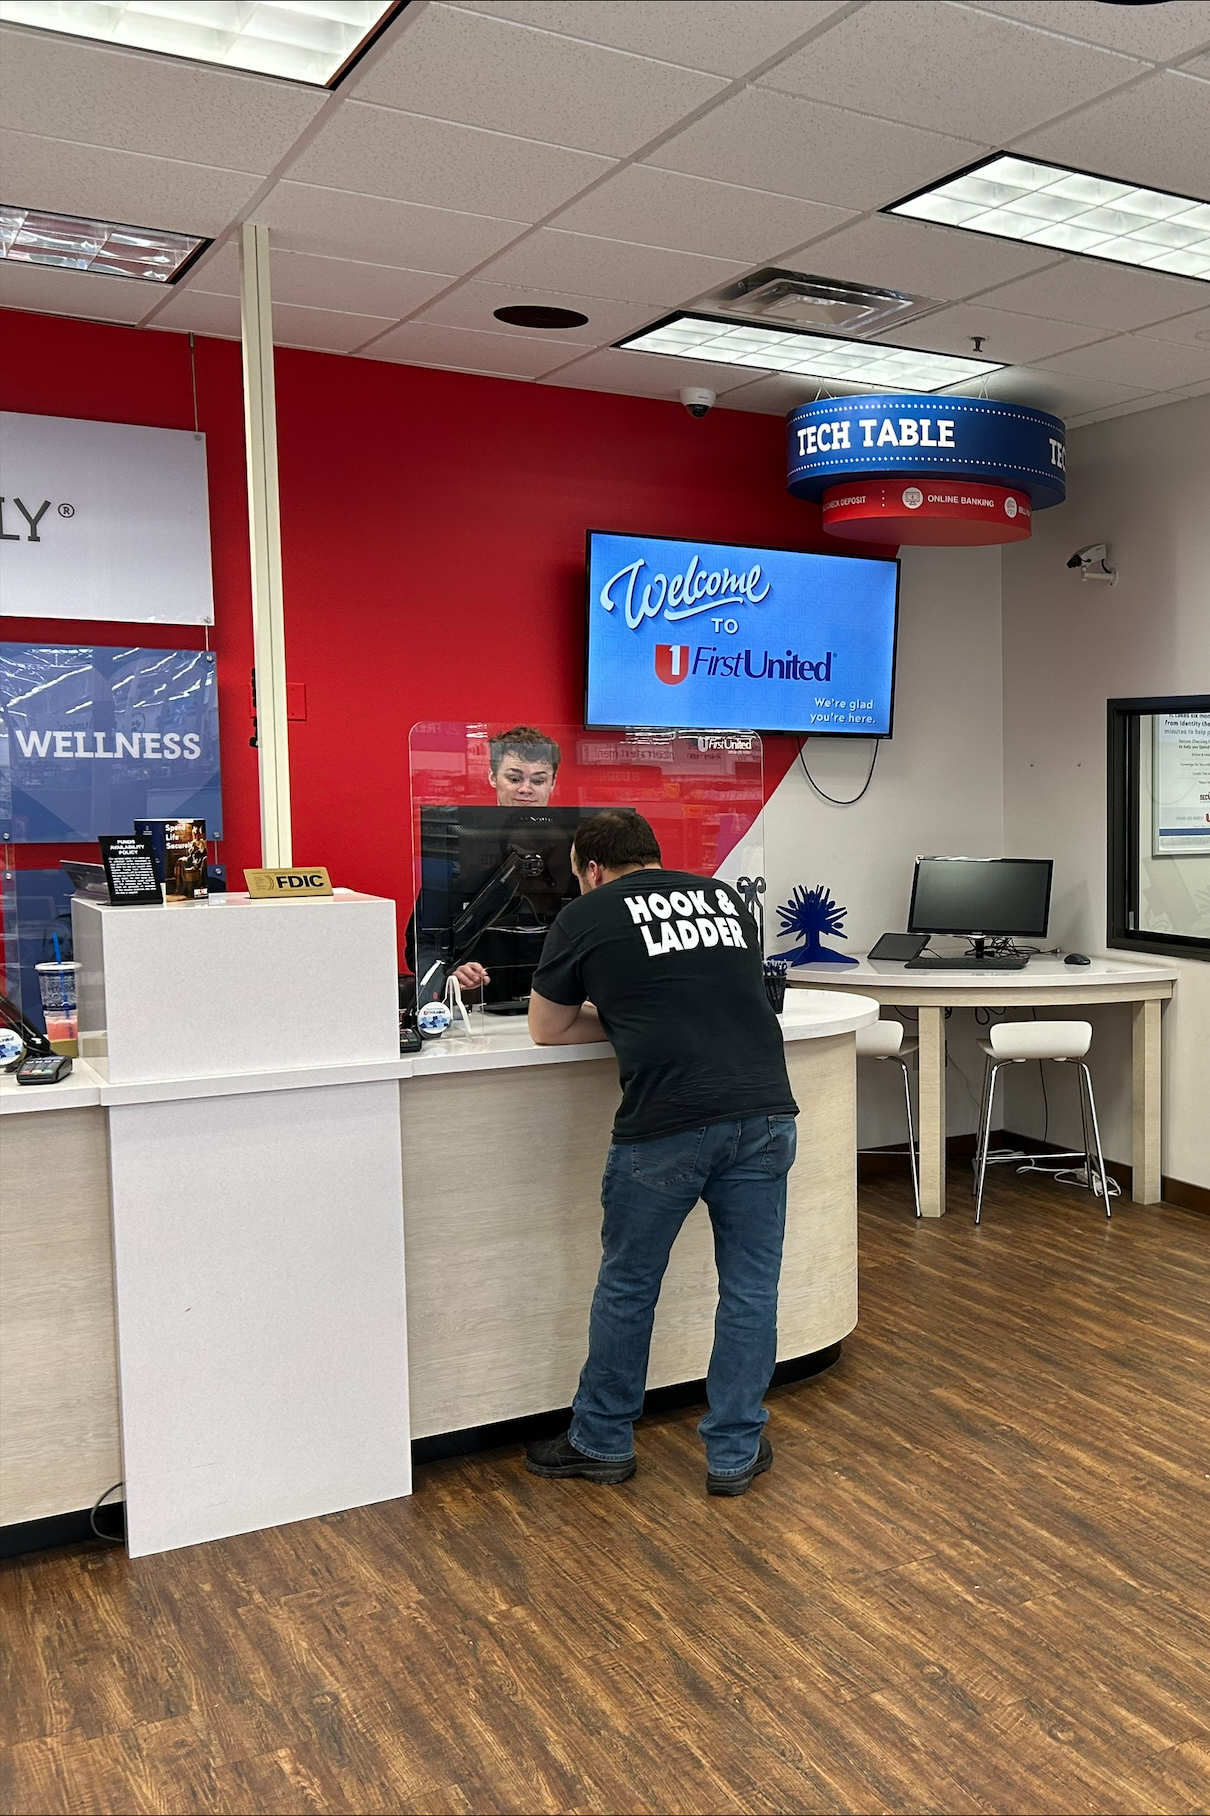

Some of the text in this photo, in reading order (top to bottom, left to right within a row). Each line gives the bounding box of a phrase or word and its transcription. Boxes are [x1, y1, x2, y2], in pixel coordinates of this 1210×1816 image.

[797, 418, 955, 456] TECH TABLE
[840, 496, 867, 507] DEPOSIT
[927, 494, 995, 508] ONLINE BANKING
[600, 555, 771, 629] Welcome
[711, 617, 739, 635] TO
[814, 697, 874, 711] We're glad
[810, 712, 876, 724] you're here.
[1180, 720, 1200, 728] identity
[1195, 728, 1206, 736] help
[15, 730, 202, 760] WELLNESS
[165, 824, 187, 832] Spend
[166, 842, 194, 850] Securely
[276, 875, 324, 889] FDIC
[624, 889, 740, 924] HOOK &
[640, 917, 748, 957] LADDER
